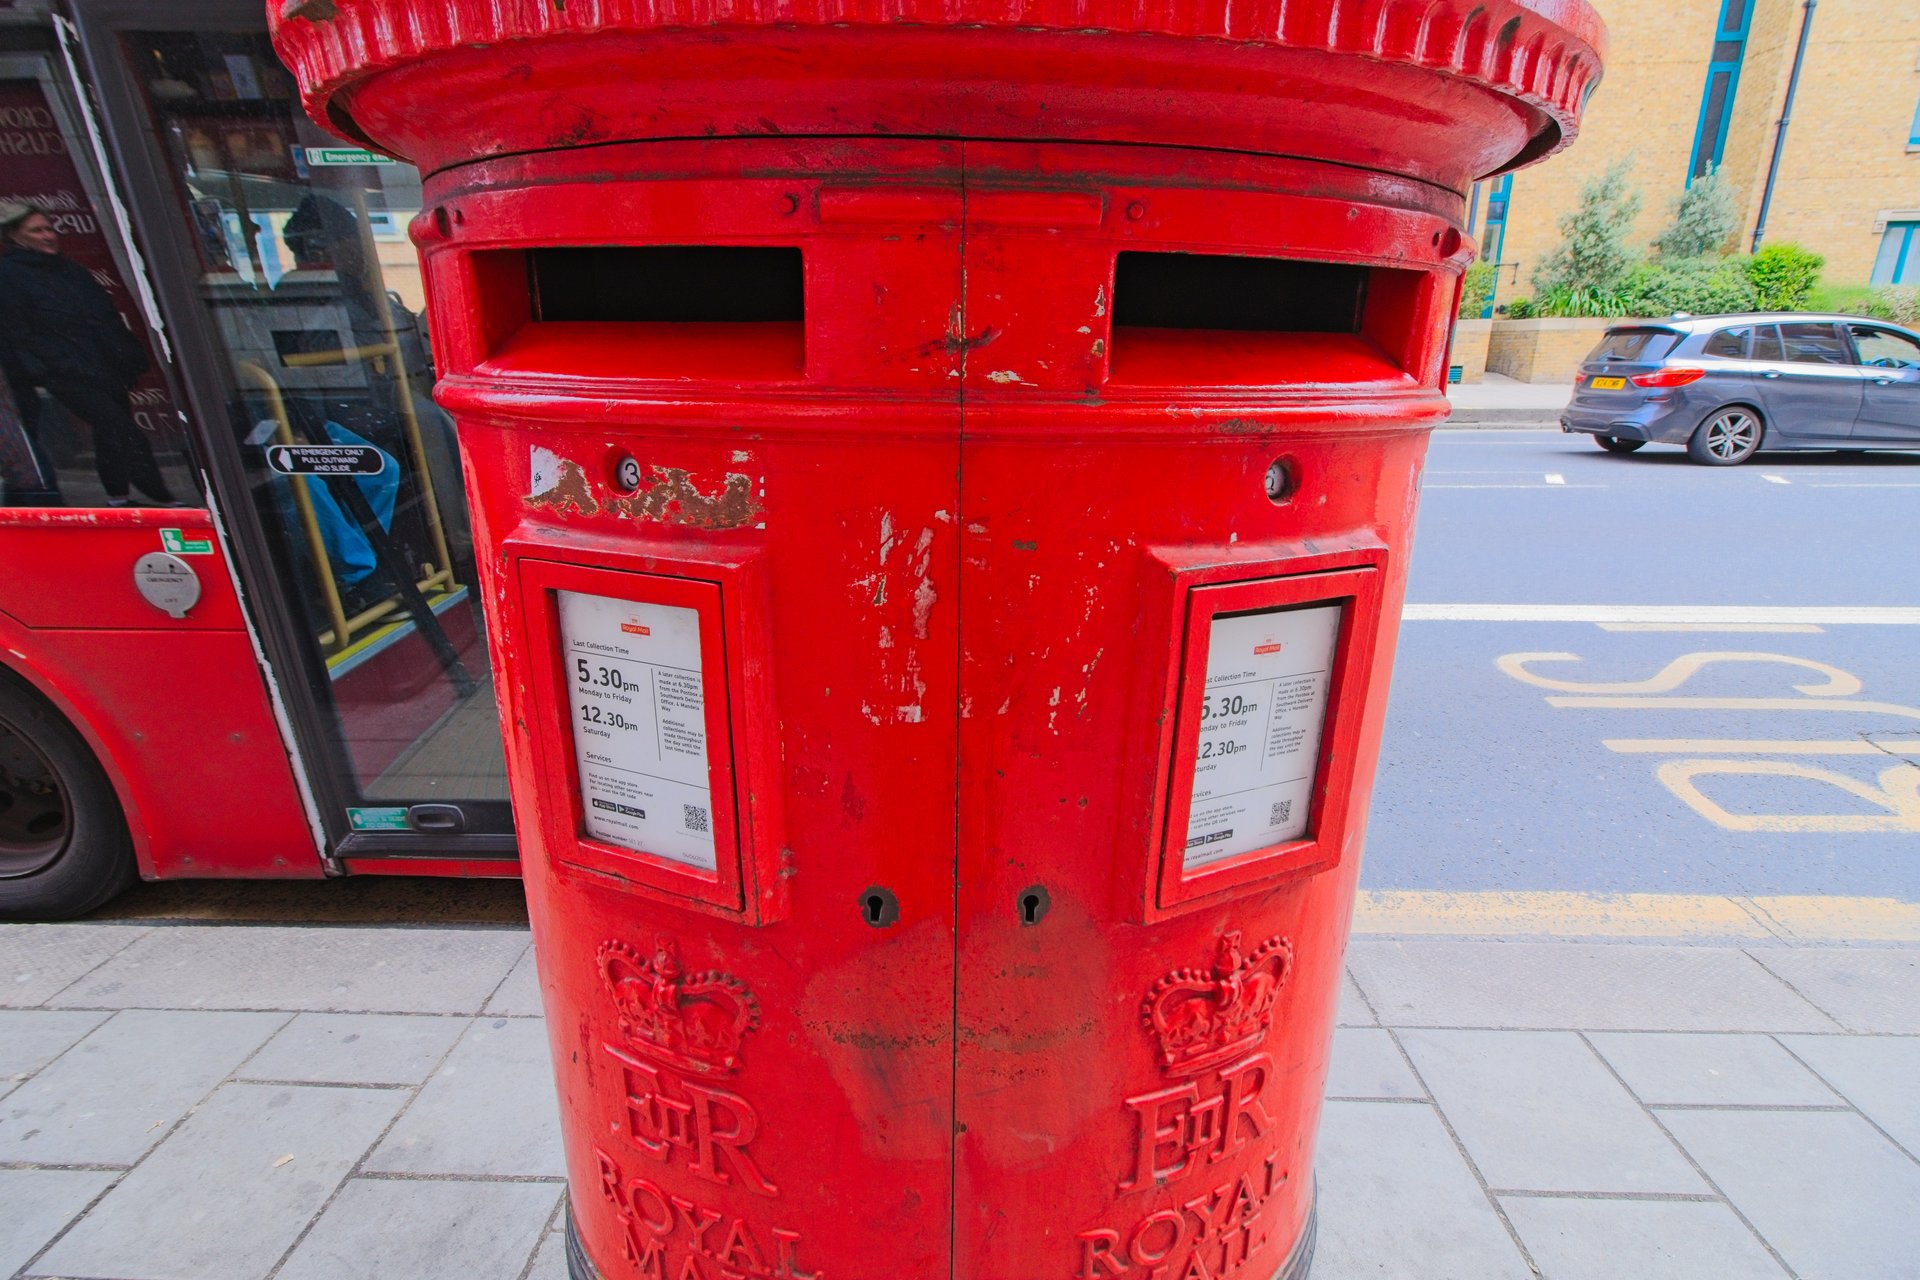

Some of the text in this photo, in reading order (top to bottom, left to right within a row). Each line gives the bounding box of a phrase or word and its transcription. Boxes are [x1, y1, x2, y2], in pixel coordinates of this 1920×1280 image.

[325, 152, 371, 163] Emergency
[625, 462, 640, 486] 3
[622, 624, 649, 634] Royal Mail
[586, 642, 613, 652] Collection
[615, 646, 629, 654] Time
[578, 659, 639, 692] 5.30pm
[1214, 672, 1241, 683] Collection
[579, 687, 602, 699] Monday
[612, 693, 632, 704] Friday
[1202, 695, 1258, 720] 5.30pm
[581, 704, 639, 731] 12.30pm
[583, 726, 610, 738] Saturday
[1200, 724, 1219, 732] onday
[1229, 719, 1248, 728] Friday
[586, 751, 612, 763] Services
[1195, 763, 1217, 774] turday
[1191, 789, 1212, 798] rvices
[593, 1143, 824, 1280] ROYAL
[1075, 1148, 1288, 1280] ROYAL
[1152, 1212, 1266, 1280] AIL
